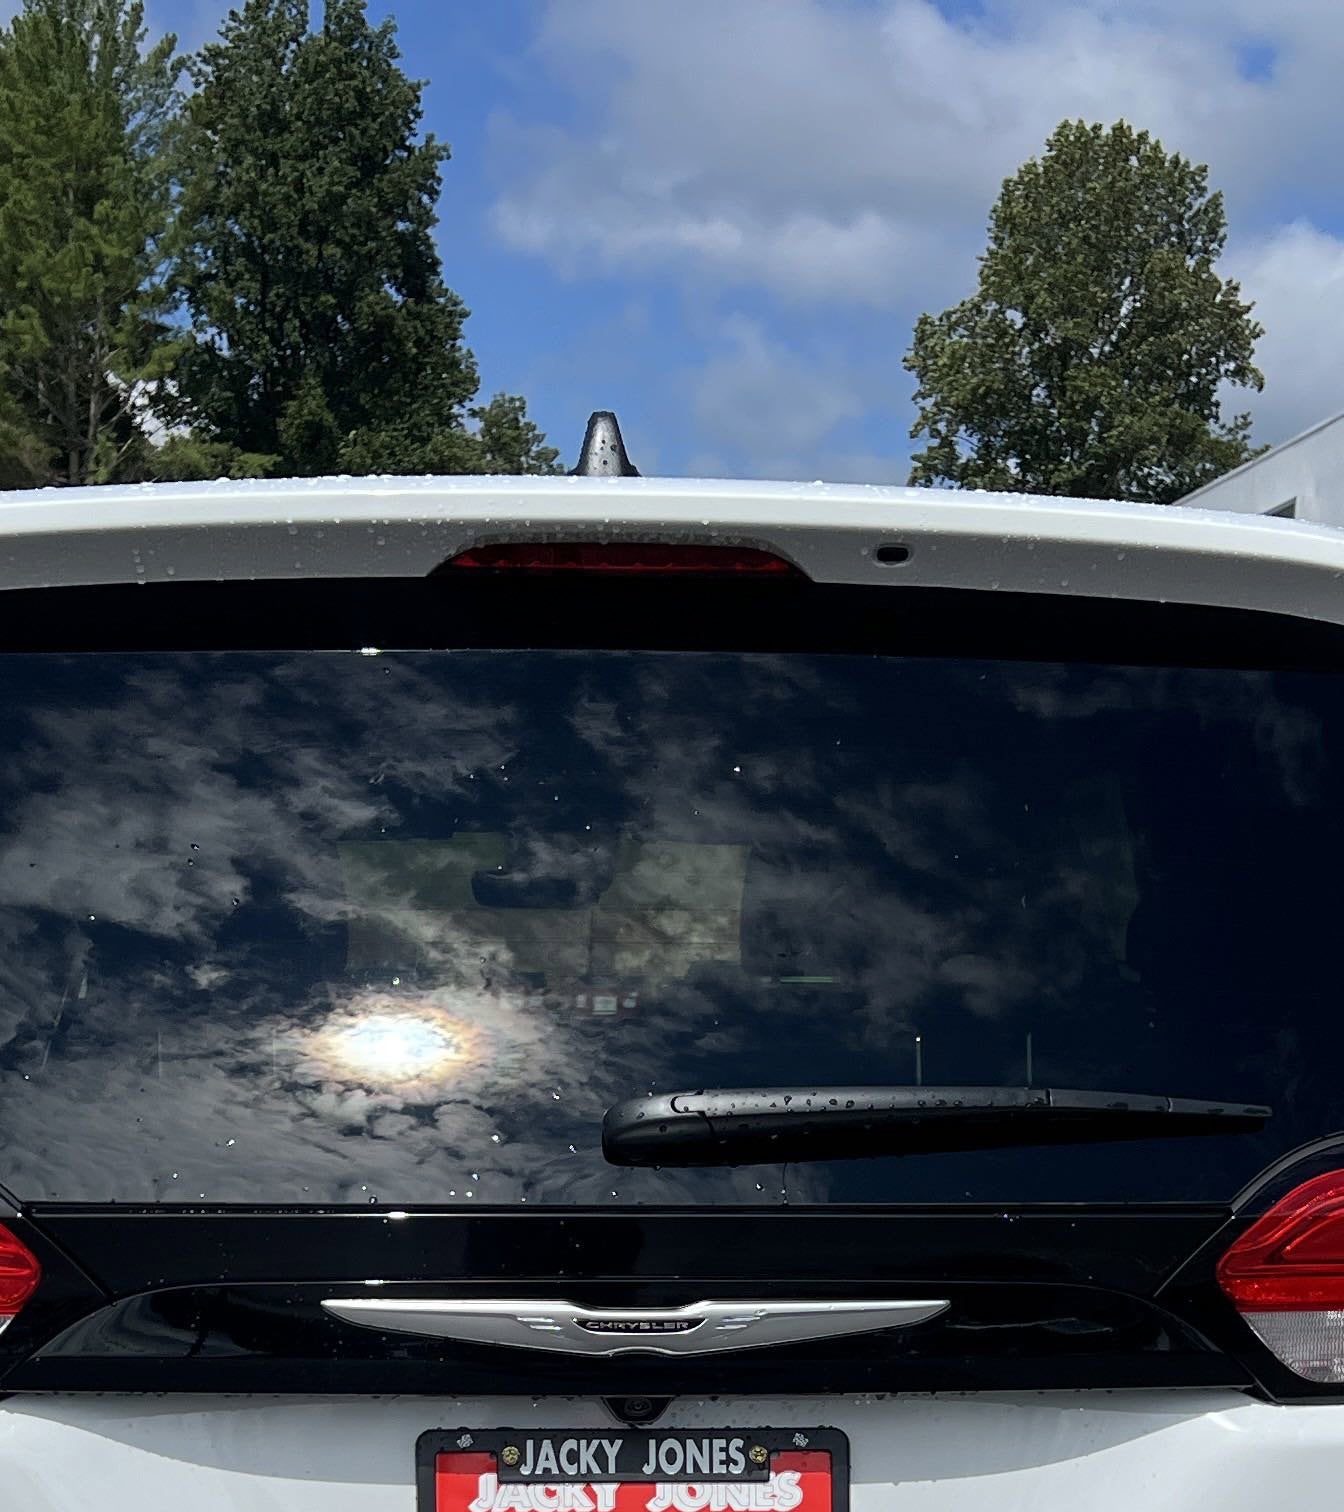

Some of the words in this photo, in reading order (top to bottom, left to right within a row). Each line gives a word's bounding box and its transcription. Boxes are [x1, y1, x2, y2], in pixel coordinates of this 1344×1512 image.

[585, 1321, 689, 1330] CHRYSLER
[519, 1439, 623, 1475] JACKY
[641, 1438, 747, 1475] JONES
[646, 1471, 803, 1512] JONES
